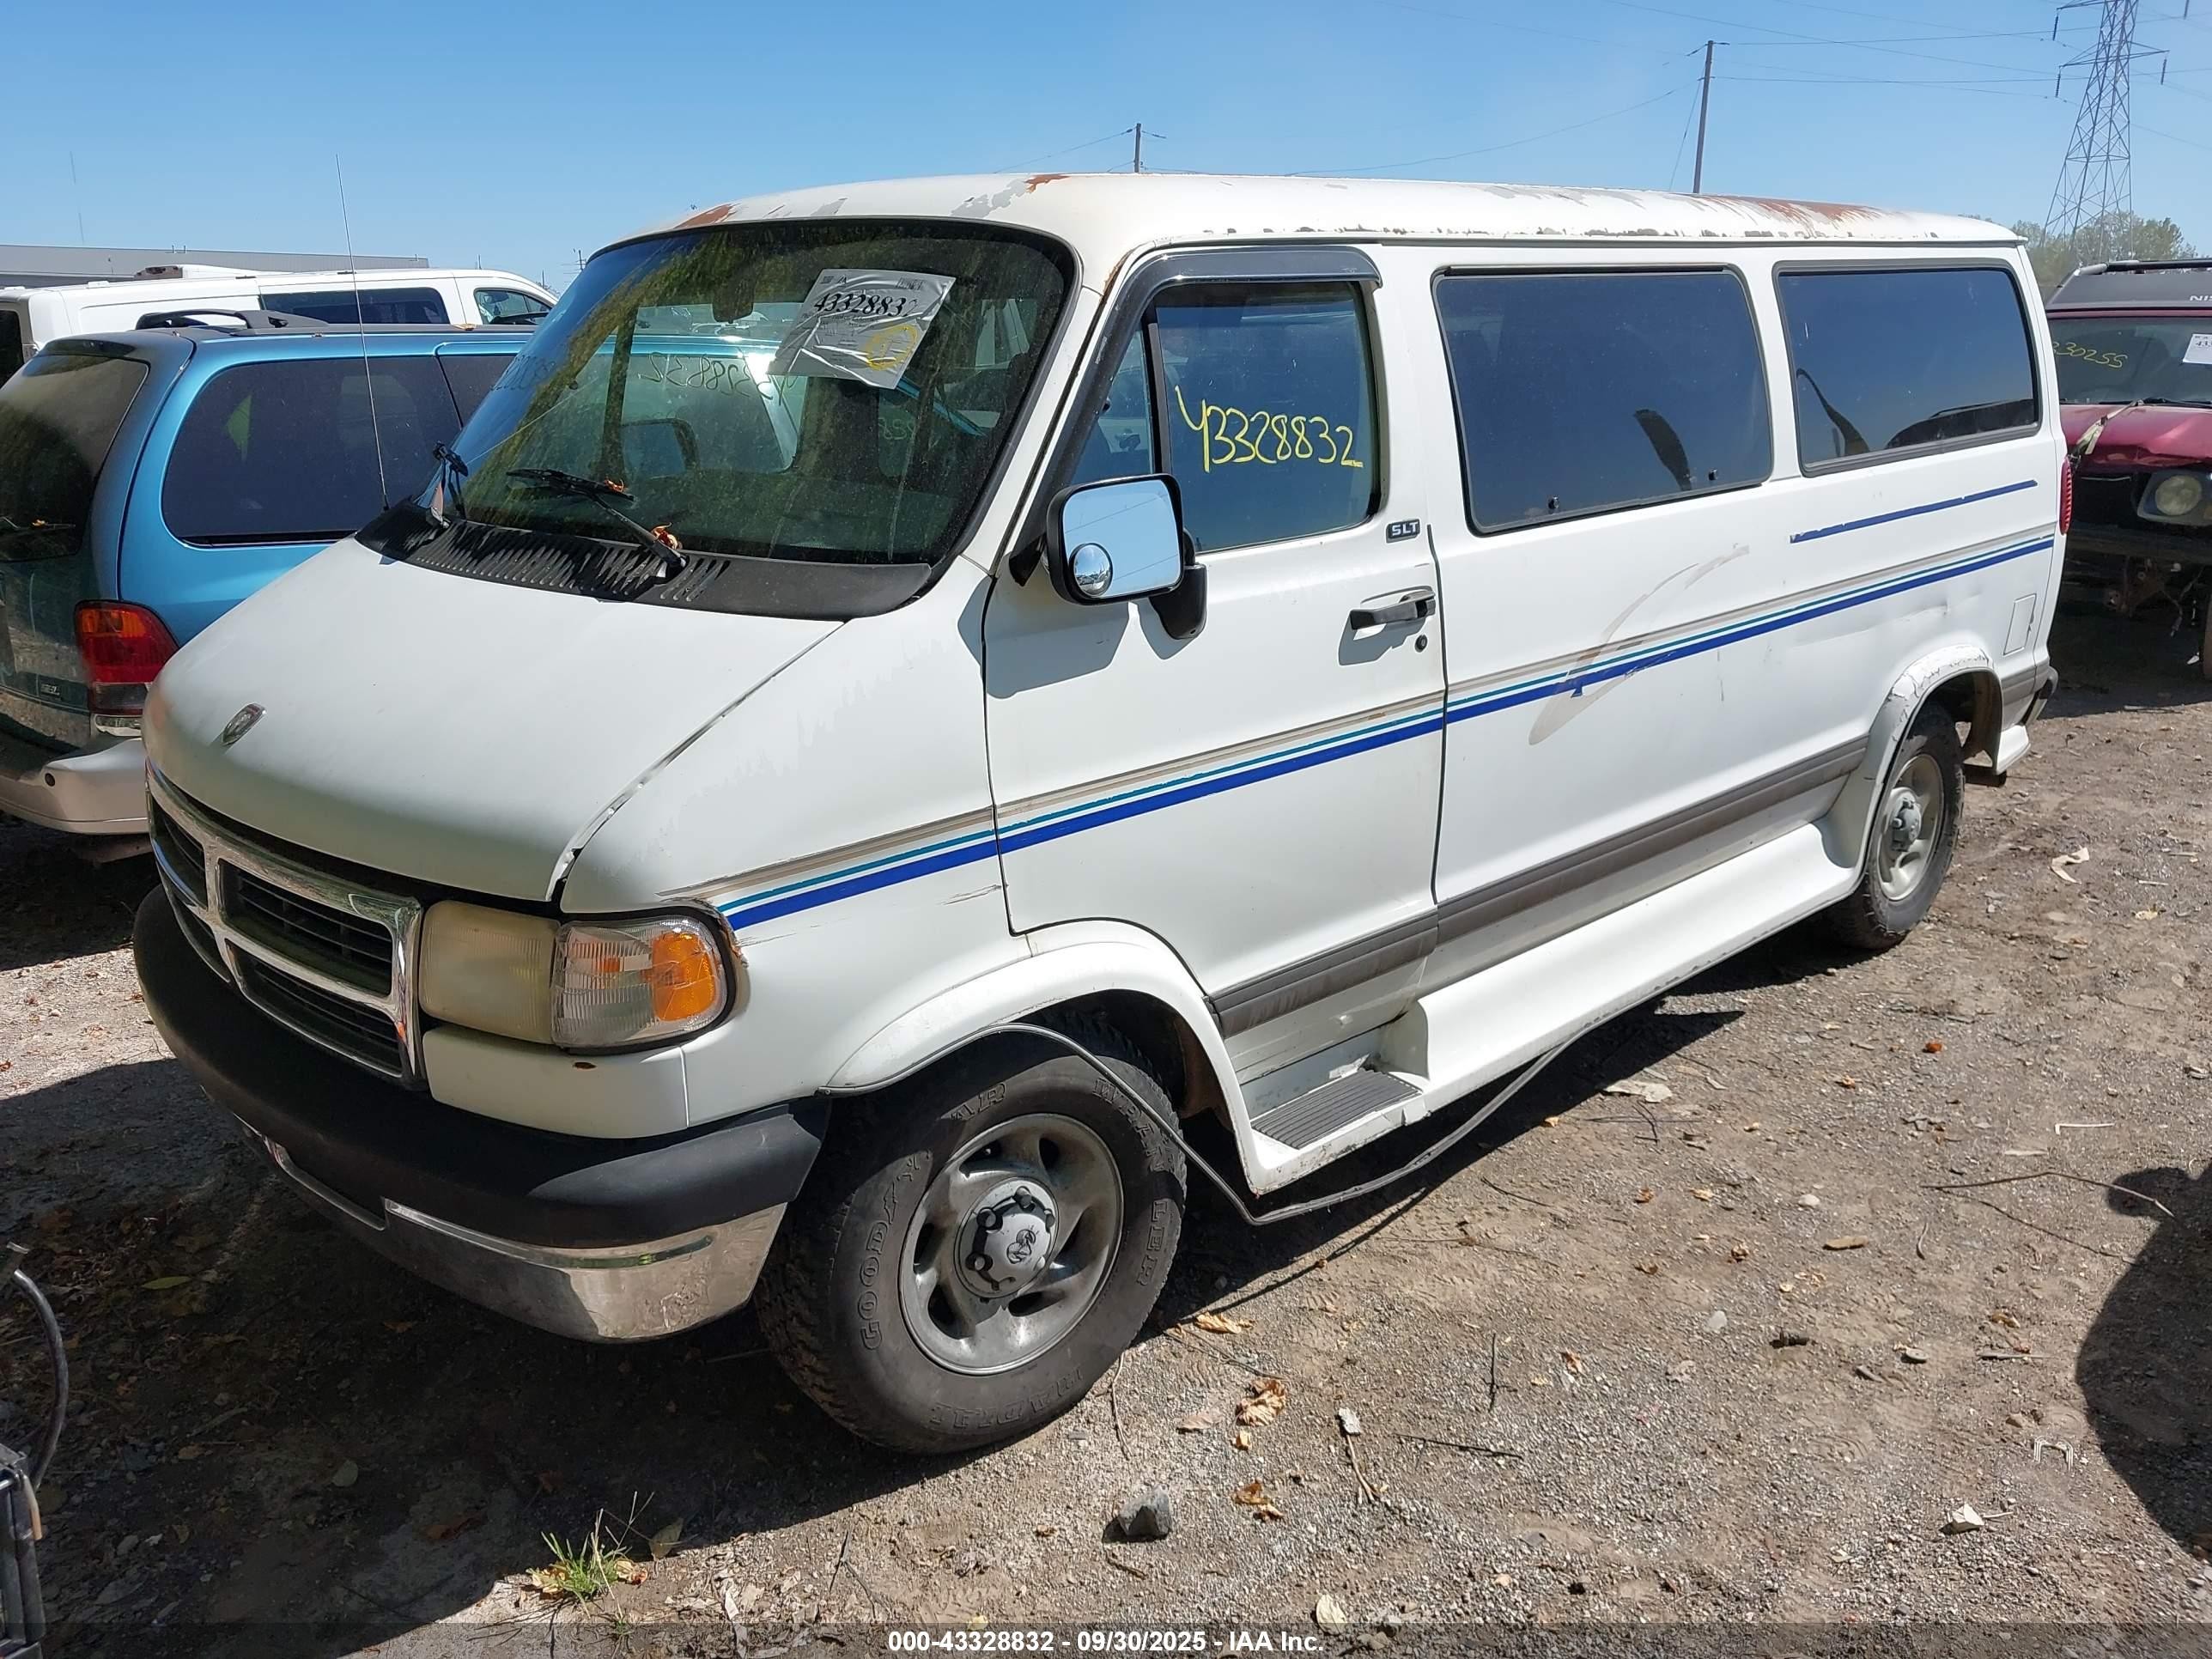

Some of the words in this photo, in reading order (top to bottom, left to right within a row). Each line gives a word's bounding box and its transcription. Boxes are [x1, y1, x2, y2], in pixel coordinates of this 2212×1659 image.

[813, 292, 918, 319] 43328832
[1175, 385, 1364, 472] 43328832
[1392, 522, 1419, 537] SLT
